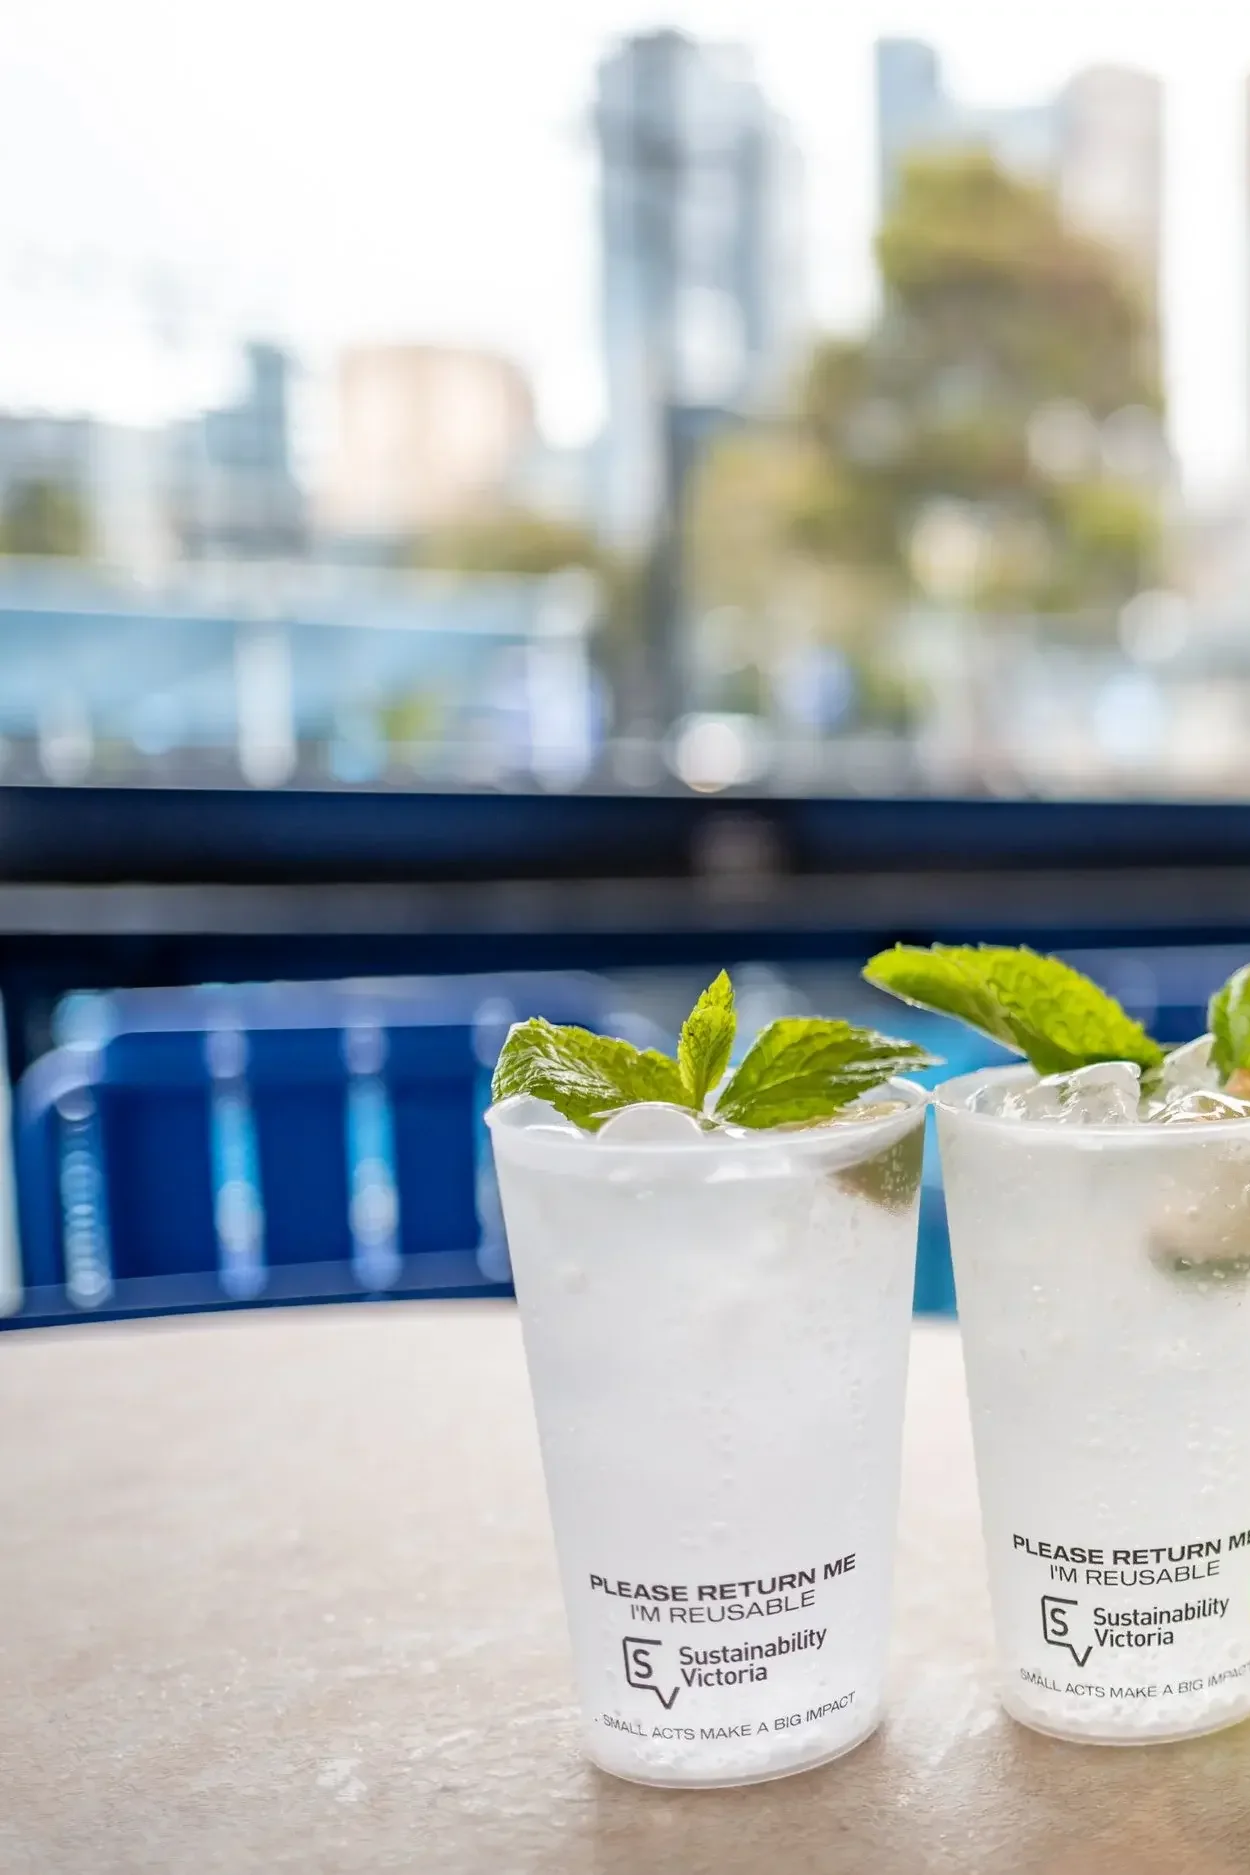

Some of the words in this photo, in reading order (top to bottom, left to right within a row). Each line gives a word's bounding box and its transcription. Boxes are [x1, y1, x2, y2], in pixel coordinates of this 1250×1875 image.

[1013, 1533, 1104, 1565] PLEASE
[1112, 1538, 1221, 1565] RETURN
[589, 1573, 688, 1602] PLEASE
[698, 1568, 816, 1602] RETURN
[823, 1553, 856, 1580] ME
[1050, 1564, 1077, 1583] I'M
[1086, 1559, 1221, 1587] REUSABLE
[630, 1604, 661, 1623] I'M
[669, 1589, 815, 1623] REUSABLE
[1093, 1598, 1230, 1627] Sustainability
[679, 1628, 827, 1666] Sustainability
[1094, 1628, 1175, 1648] Victoria
[681, 1665, 768, 1688] Victoria
[1020, 1668, 1062, 1693] SMALL
[1065, 1683, 1105, 1699] ACTS
[1109, 1685, 1157, 1699] MAKE
[1162, 1684, 1174, 1696] A
[1178, 1679, 1203, 1695] BIG
[603, 1714, 648, 1738] SMALL
[651, 1727, 695, 1740] ACTS
[700, 1724, 752, 1740] MAKE
[756, 1723, 769, 1734] A
[774, 1714, 802, 1731] BIG
[805, 1691, 856, 1723] IMPACT
